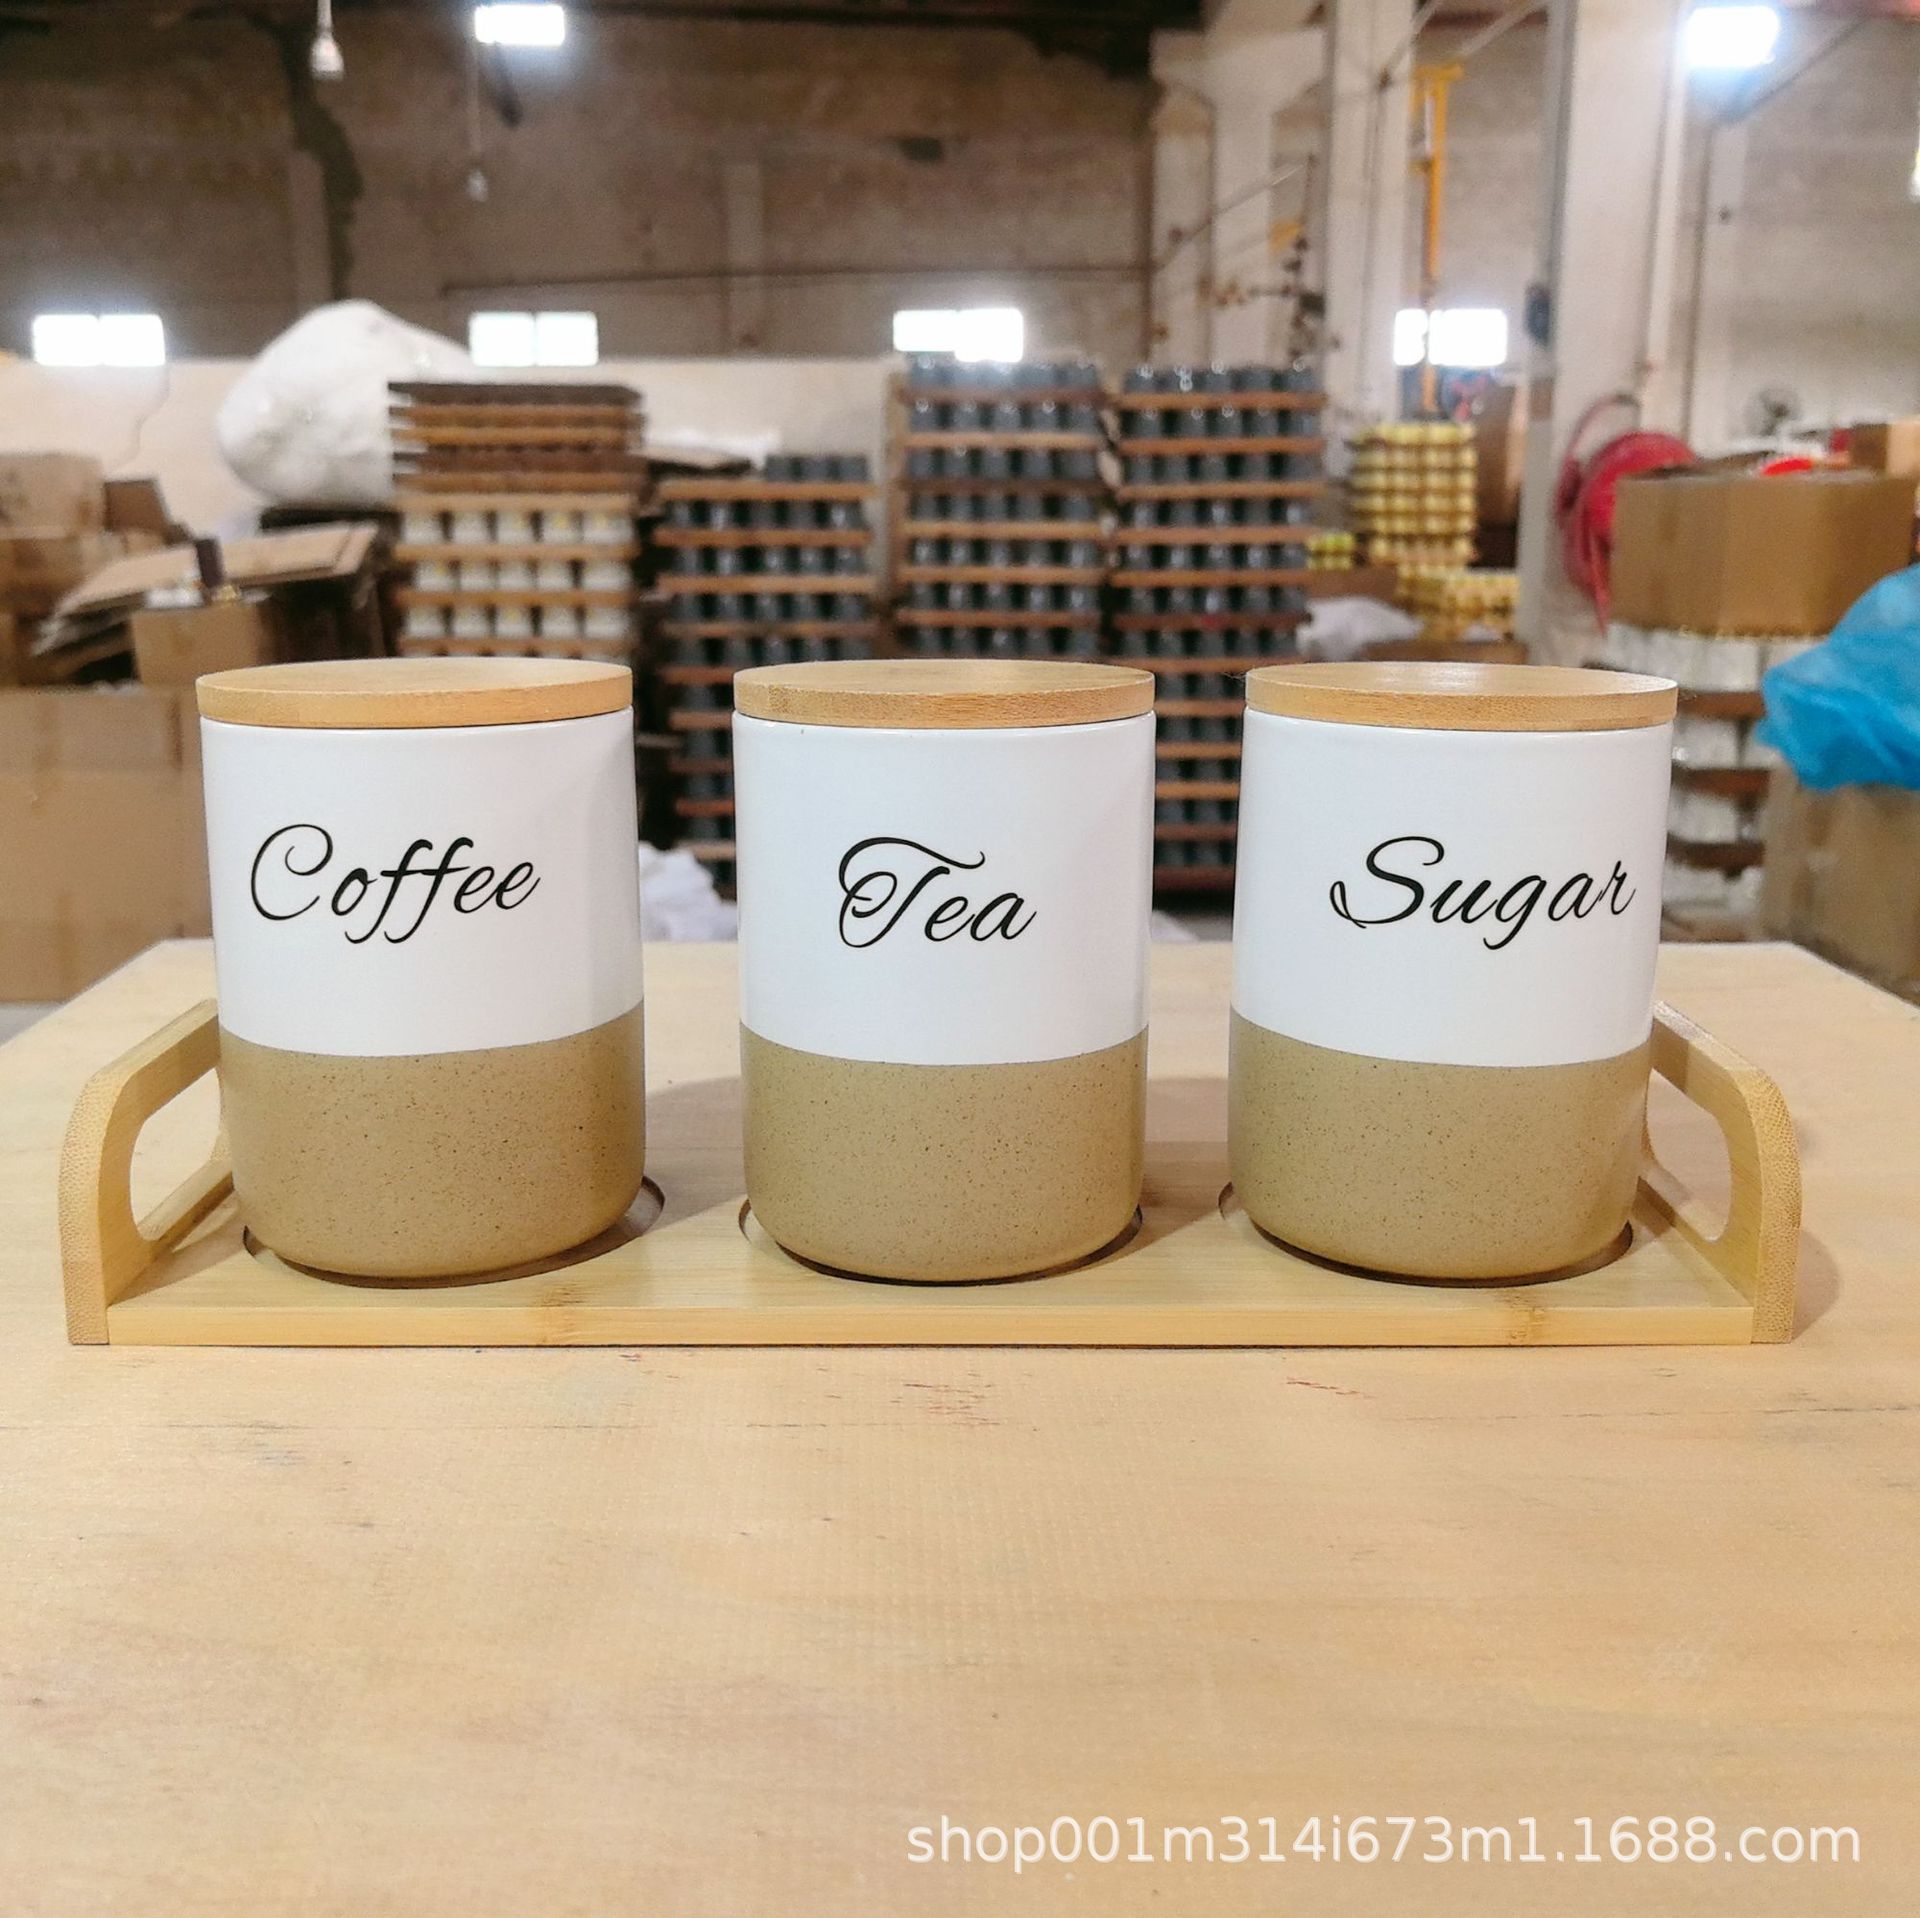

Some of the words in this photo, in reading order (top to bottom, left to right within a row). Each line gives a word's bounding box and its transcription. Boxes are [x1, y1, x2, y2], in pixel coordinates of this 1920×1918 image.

[250, 823, 541, 945] Coffee
[838, 836, 1037, 949] Tea
[1329, 835, 1636, 951] Sugar
